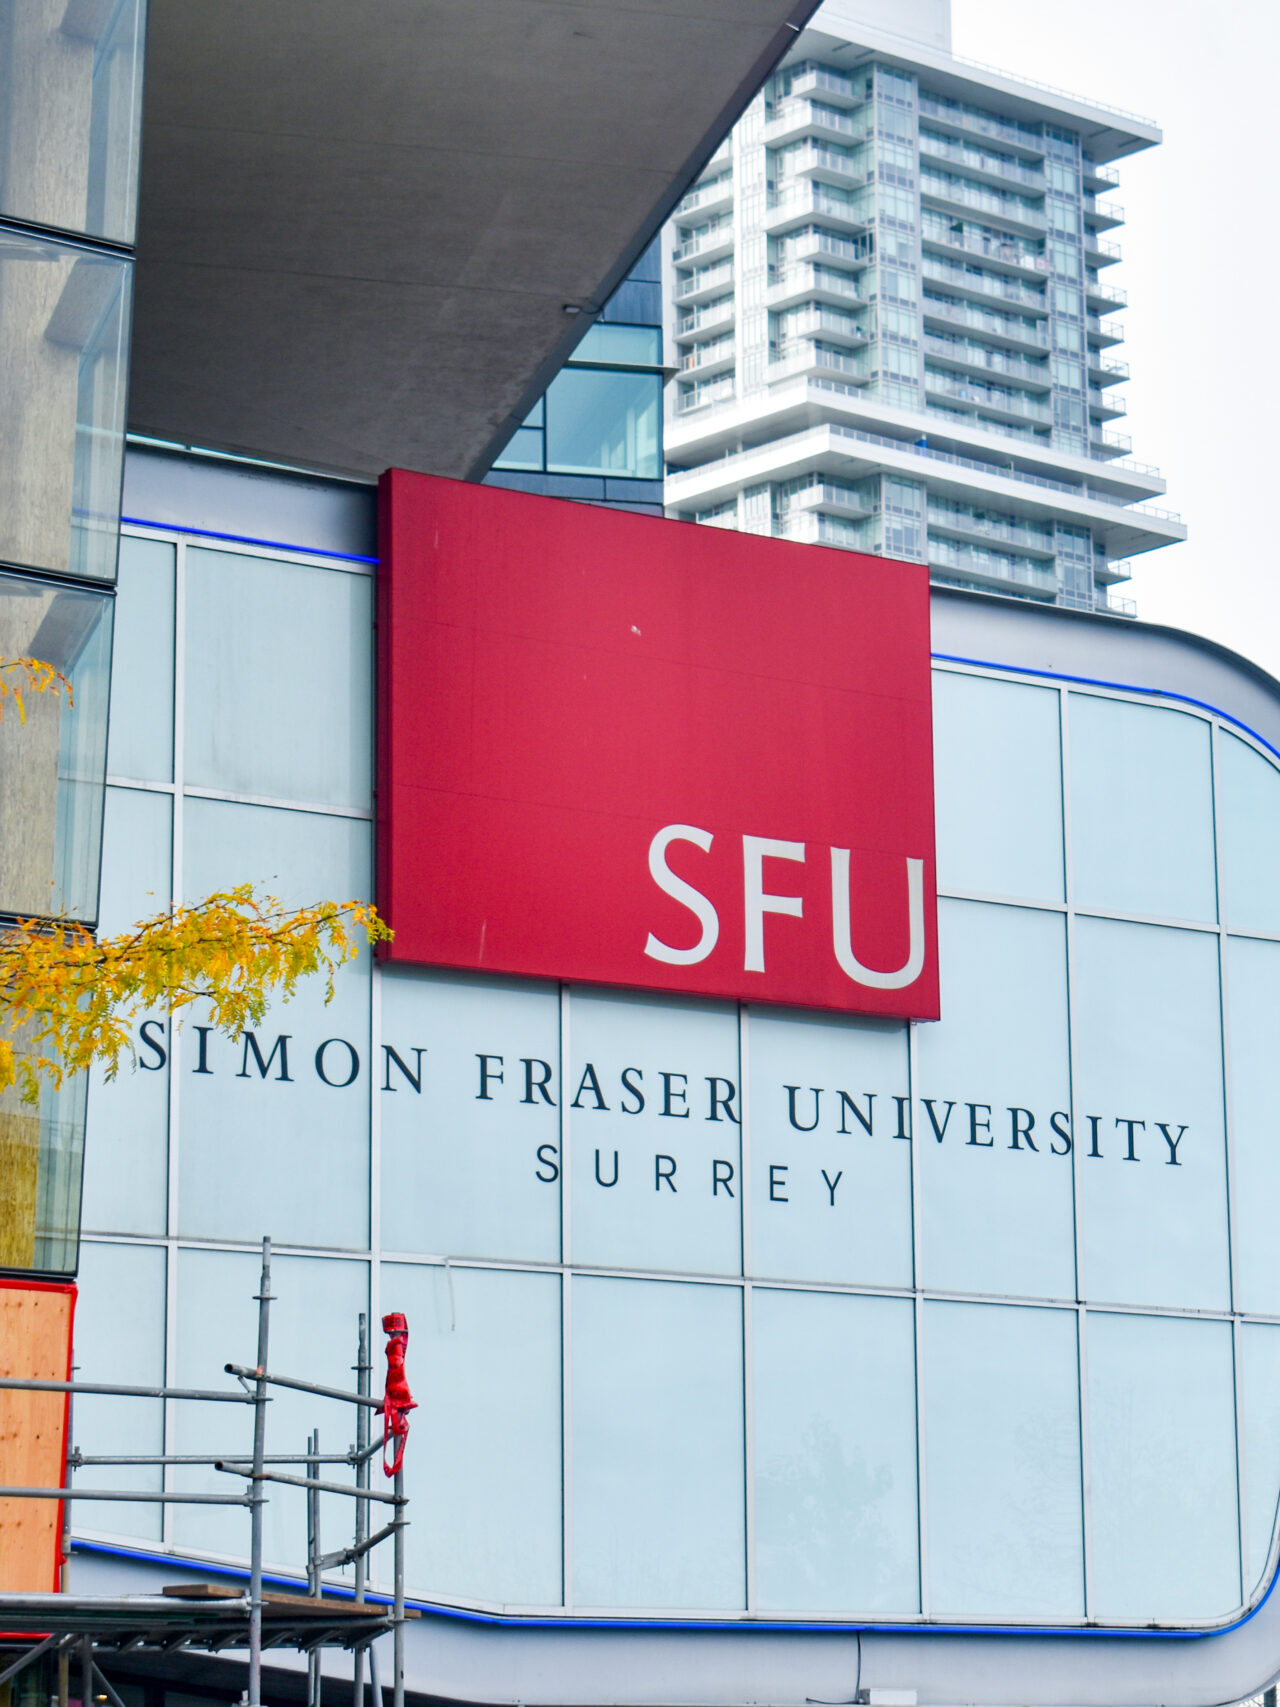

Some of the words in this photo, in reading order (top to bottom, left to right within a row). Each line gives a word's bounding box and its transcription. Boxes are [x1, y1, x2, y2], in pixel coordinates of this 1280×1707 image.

[644, 824, 925, 989] SFU
[139, 1021, 427, 1094] SIMON
[475, 1055, 742, 1124] FRASER
[784, 1086, 1189, 1166] UNIVERSITY
[536, 1145, 843, 1207] SURREY
